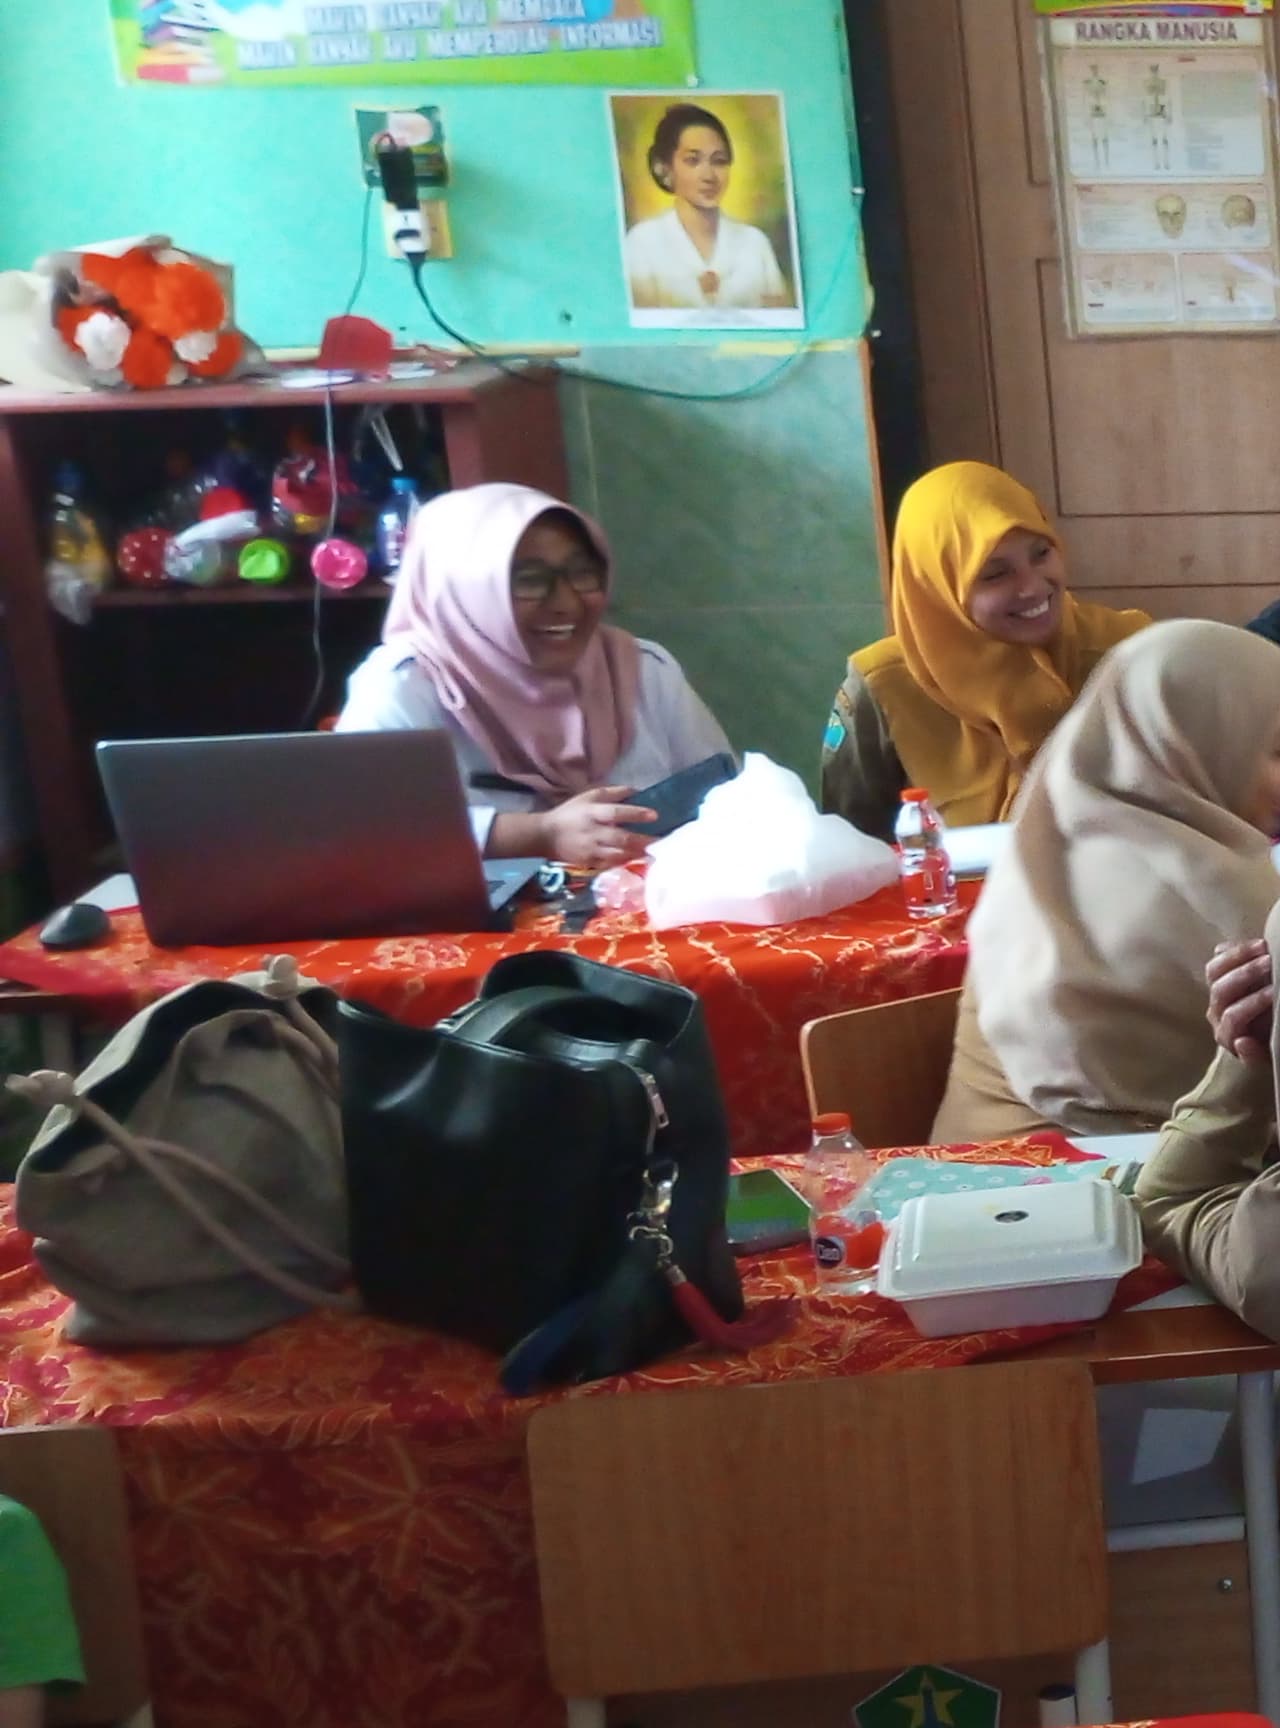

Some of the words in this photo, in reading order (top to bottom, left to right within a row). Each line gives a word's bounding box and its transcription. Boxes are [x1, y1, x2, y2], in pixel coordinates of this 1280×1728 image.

[560, 18, 661, 50] INFORMASI
[1075, 21, 1150, 41] RANGKA
[1156, 21, 1238, 40] MANUSIA
